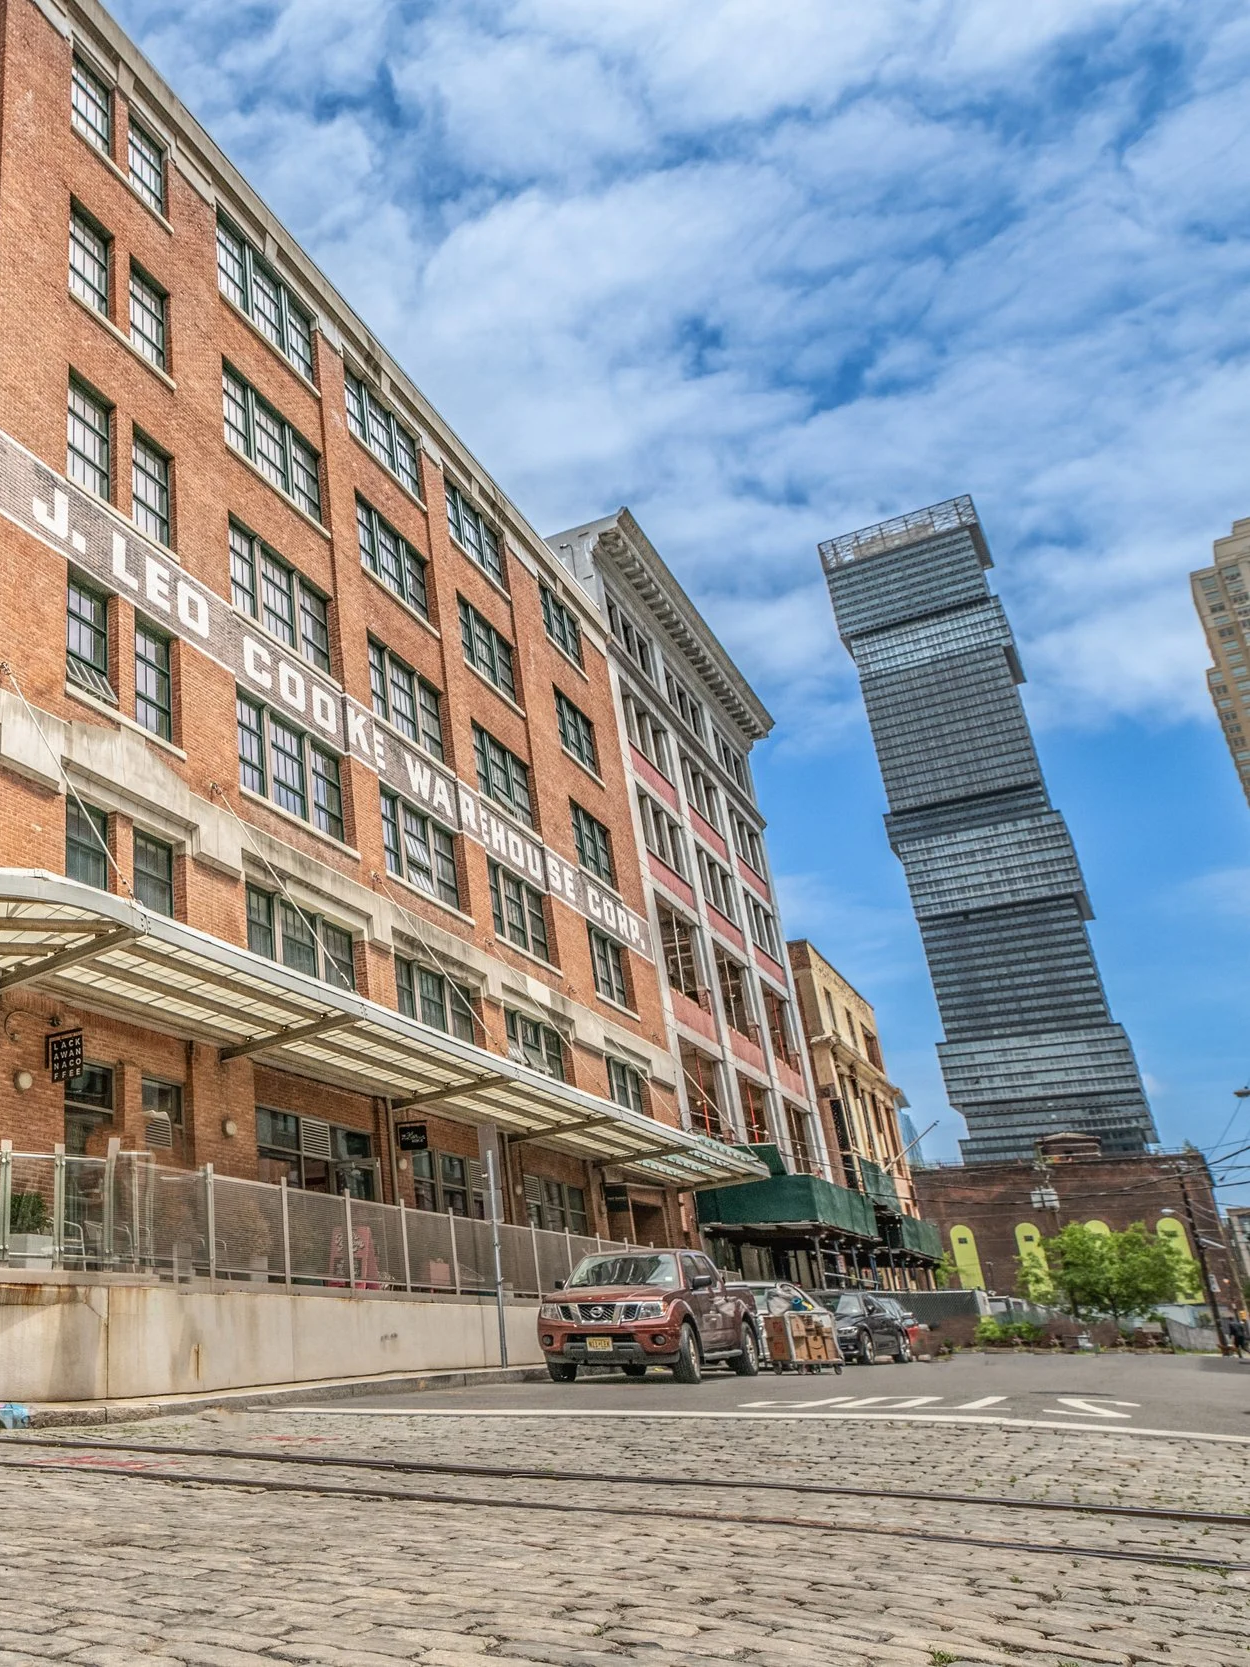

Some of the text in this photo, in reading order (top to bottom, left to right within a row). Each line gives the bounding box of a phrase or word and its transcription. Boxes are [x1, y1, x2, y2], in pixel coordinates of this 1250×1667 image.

[32, 487, 646, 951] J. LEO COOKE WAREHOUSE CORP.
[53, 1037, 81, 1051] LACK
[53, 1047, 81, 1061] AWAN
[53, 1057, 82, 1071] NACO
[54, 1067, 81, 1080] FFEE
